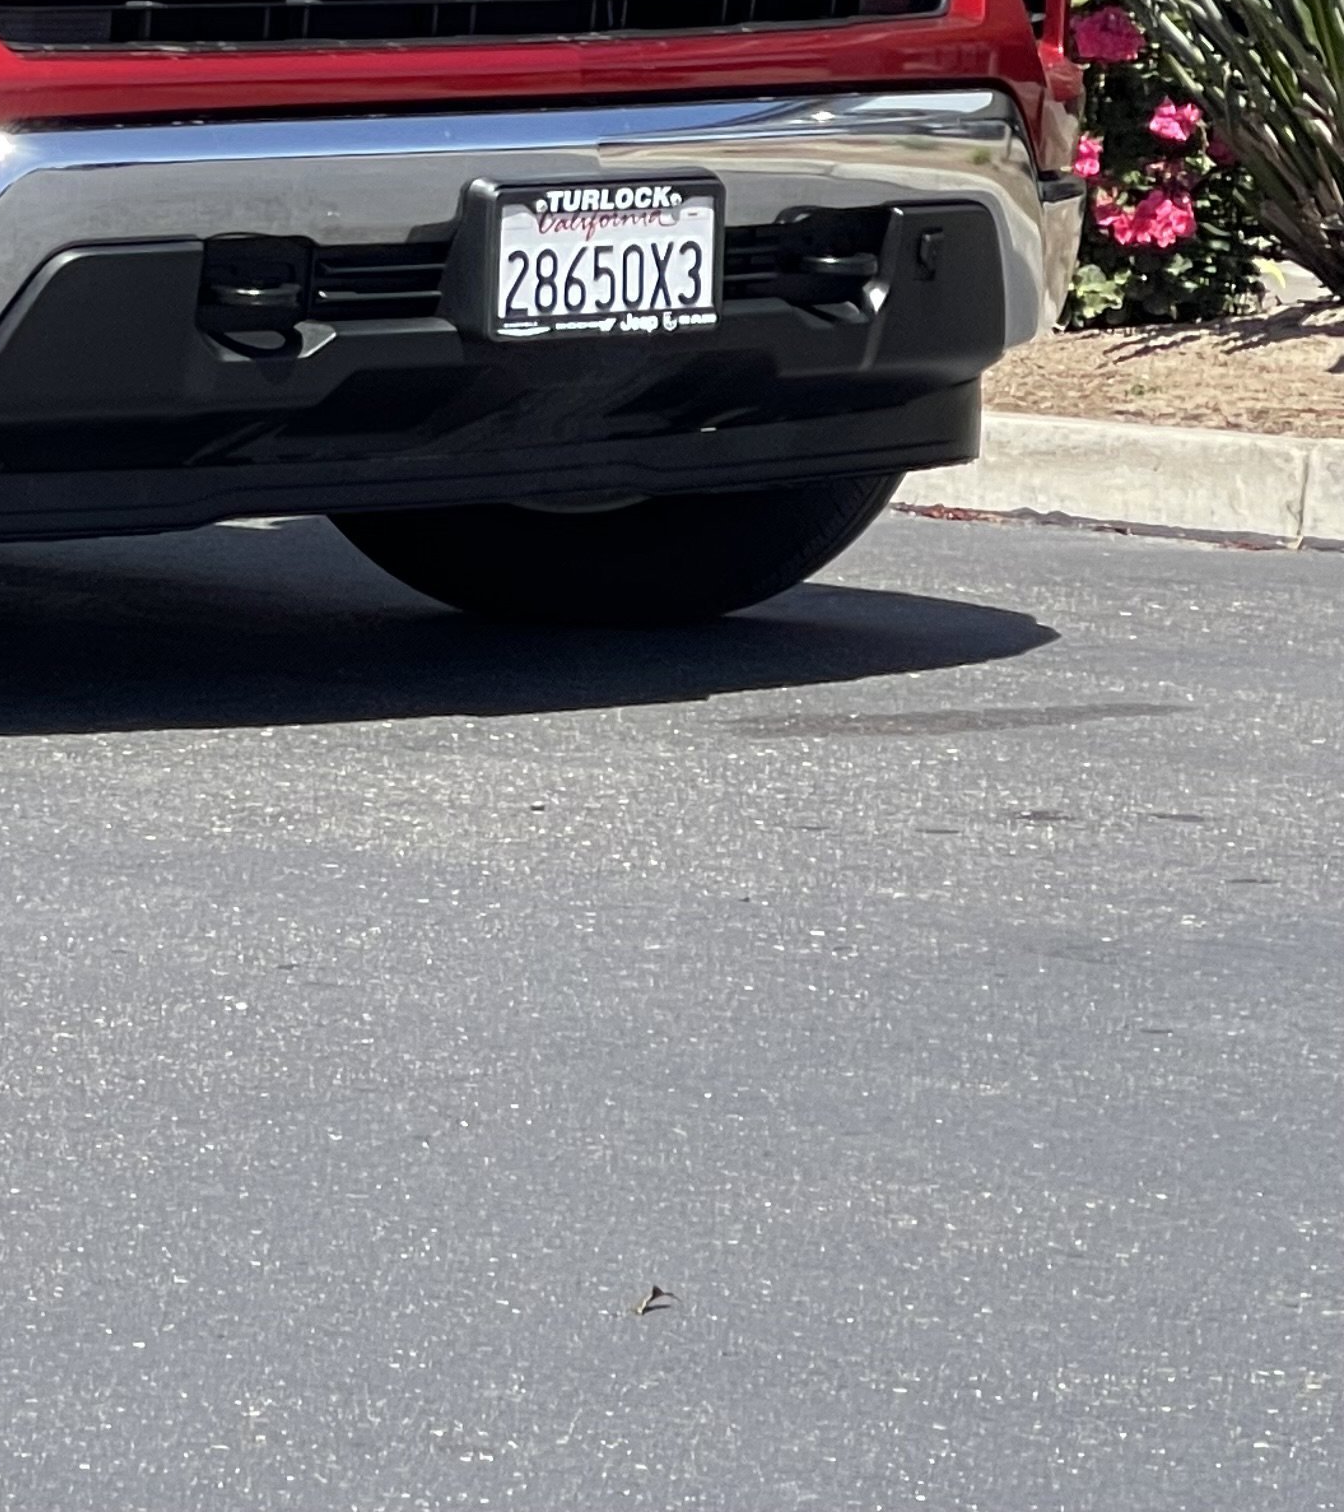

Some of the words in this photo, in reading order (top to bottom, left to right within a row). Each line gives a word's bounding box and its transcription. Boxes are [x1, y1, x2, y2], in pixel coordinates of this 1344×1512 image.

[546, 186, 673, 213] TURLOCK
[538, 207, 678, 241] California
[505, 240, 704, 318] 28650X3
